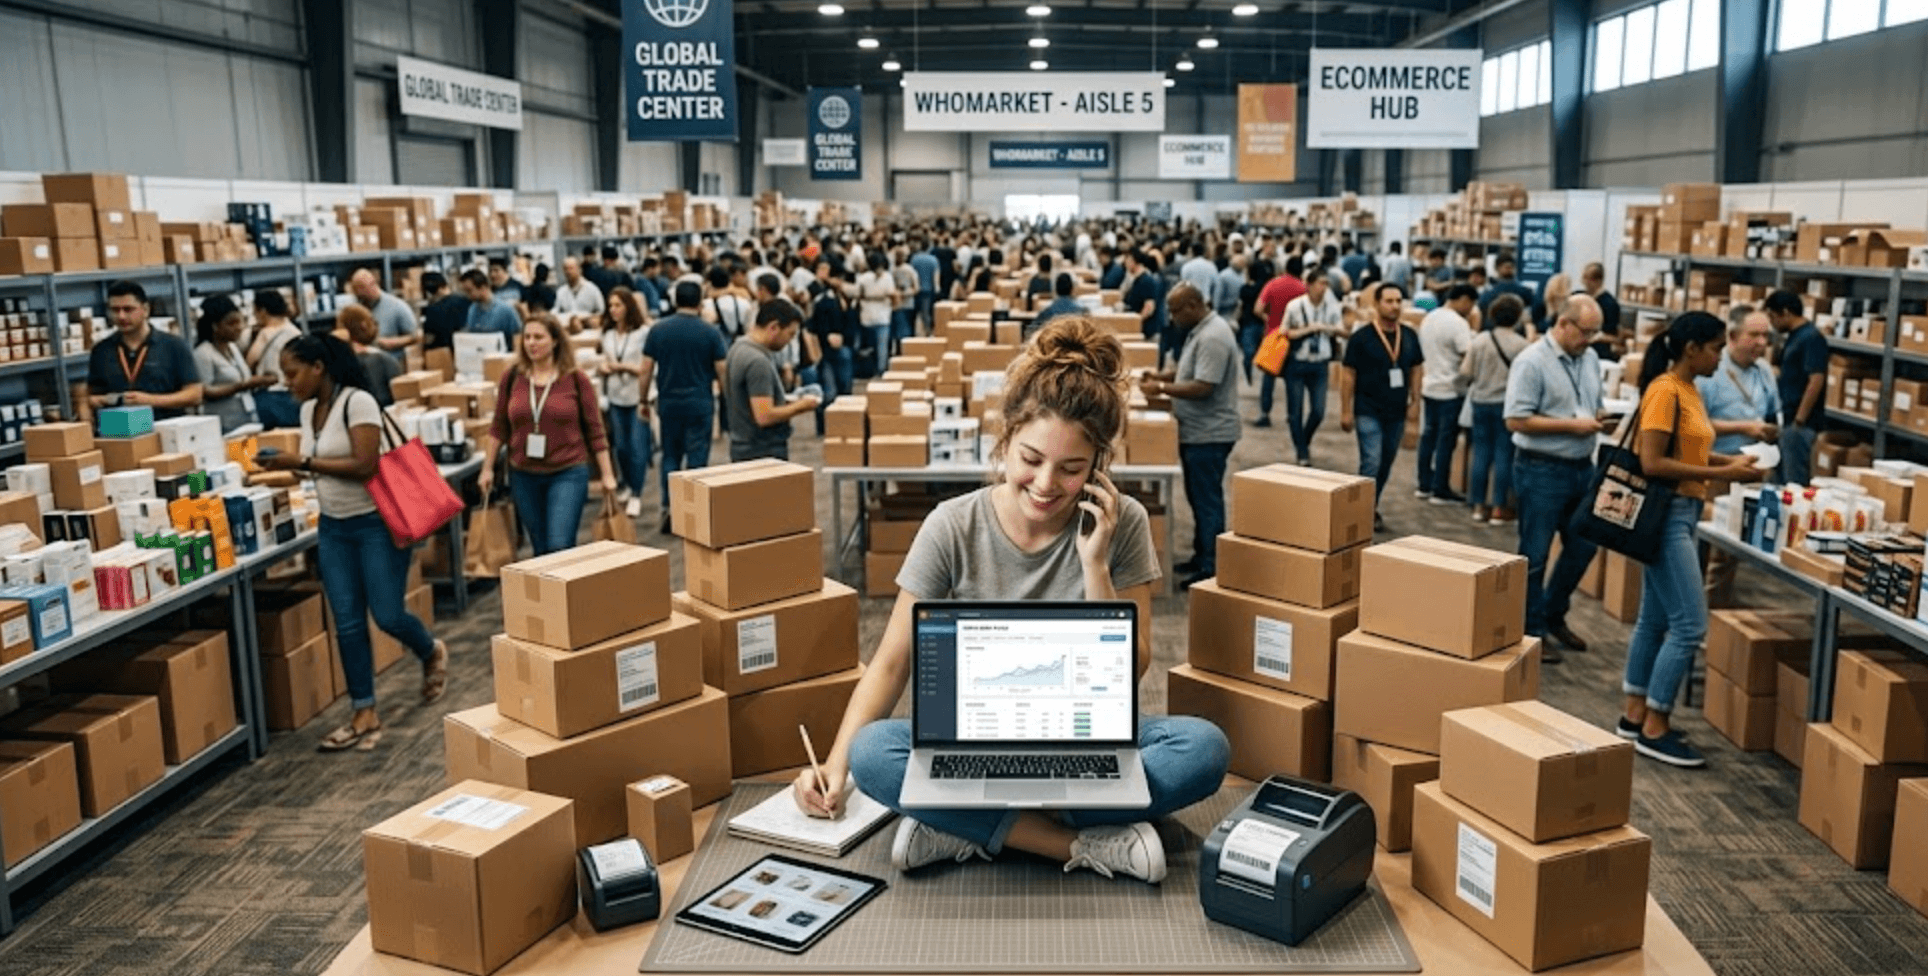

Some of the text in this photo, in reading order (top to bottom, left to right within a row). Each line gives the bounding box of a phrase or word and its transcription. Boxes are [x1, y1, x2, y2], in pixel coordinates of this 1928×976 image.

[635, 41, 725, 66] GLOBAL
[642, 68, 717, 92] TRADE
[1320, 65, 1472, 90] ECOMMERCE
[405, 73, 449, 104] GLOBAL
[450, 82, 483, 110] TRADE
[914, 91, 1053, 114] WHOMARKET
[1074, 91, 1134, 114] AISLE
[1141, 91, 1153, 114] 5
[637, 95, 725, 120] CENTER
[1370, 96, 1419, 120] HUB
